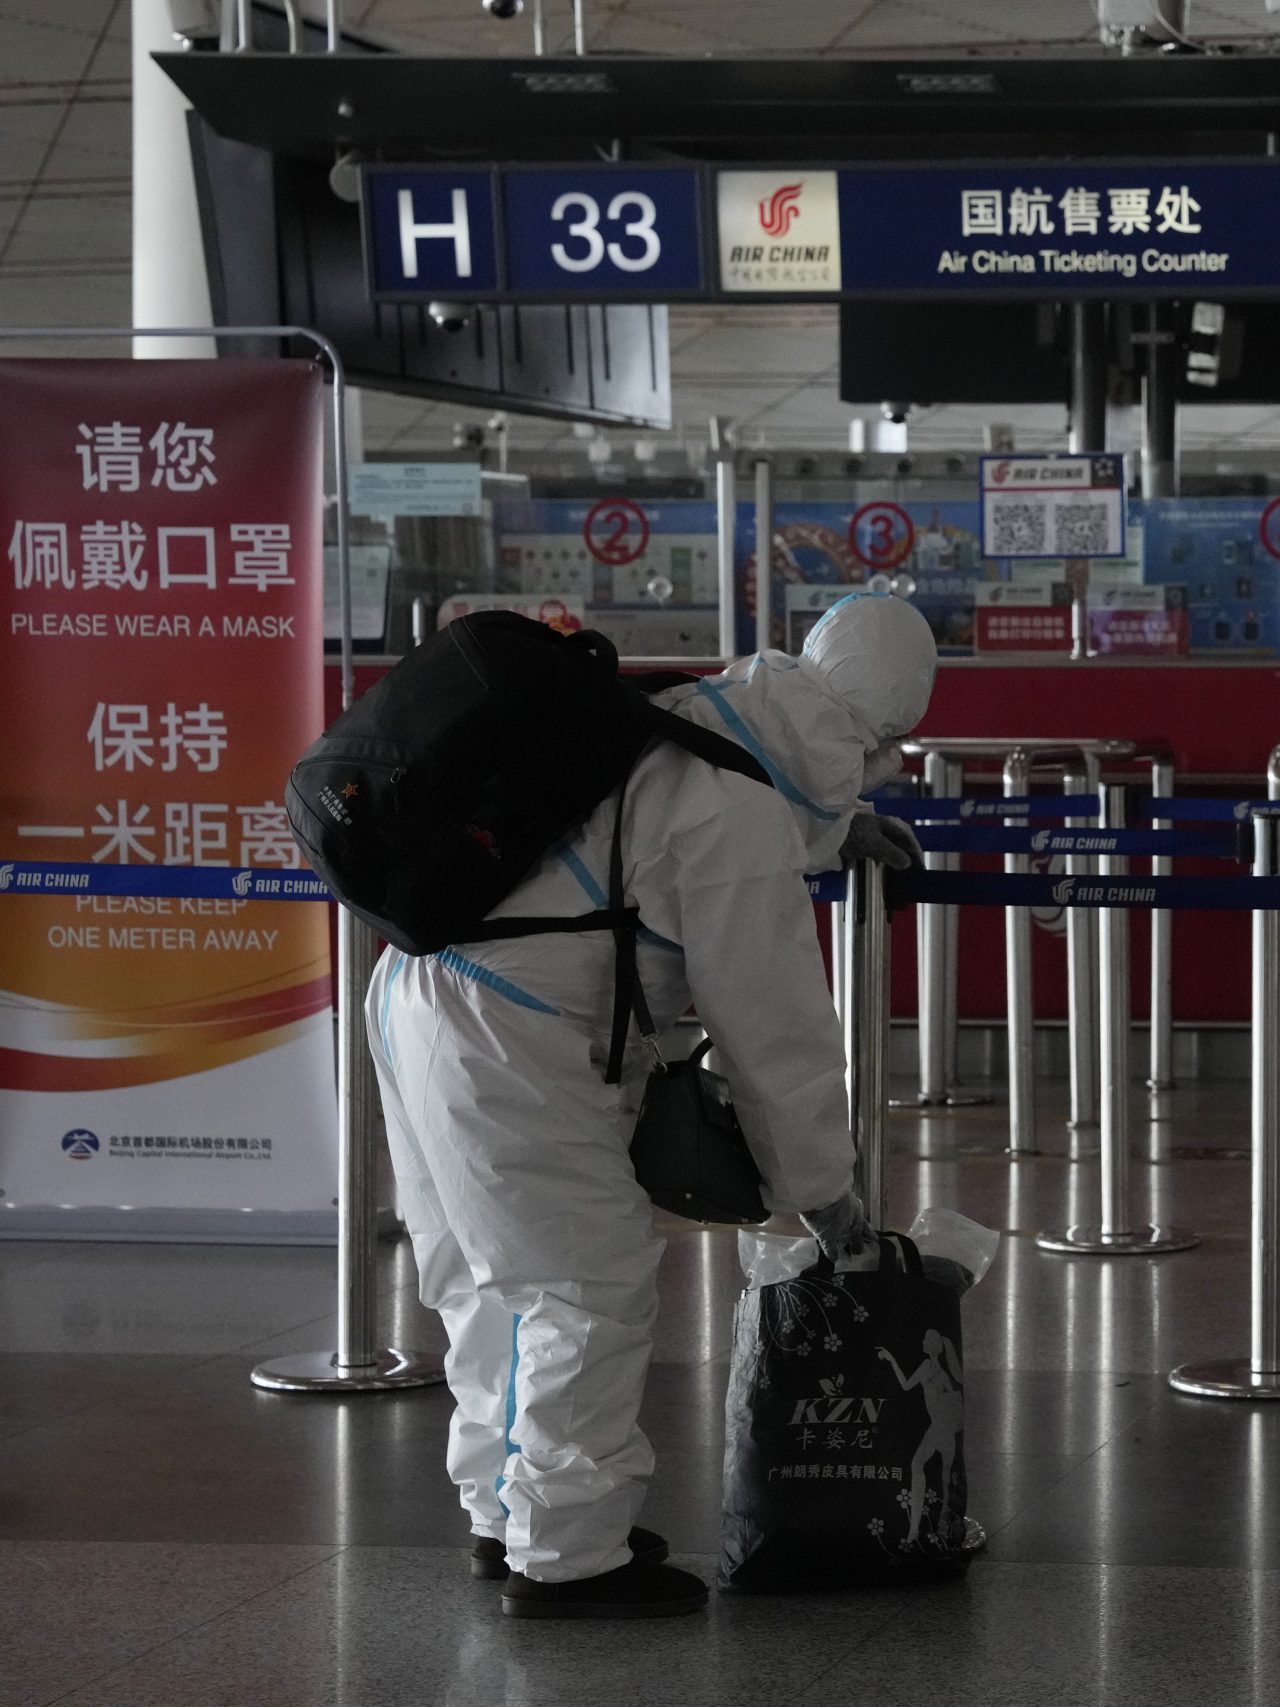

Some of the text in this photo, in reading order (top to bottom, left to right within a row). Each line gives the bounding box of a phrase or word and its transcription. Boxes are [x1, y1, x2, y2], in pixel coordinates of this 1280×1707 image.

[960, 186, 1202, 236] 国航售票处
[398, 189, 471, 278] H
[551, 191, 661, 273] 33
[730, 245, 829, 263] AIR CHINA
[937, 249, 1228, 277] Air China Ticketing Counter
[75, 421, 218, 493] 请您
[1013, 468, 1083, 480] AIR CHINA
[7, 519, 296, 591] 佩戴口罩
[11, 613, 296, 638] PLEASE WEAR A MASK
[87, 702, 228, 773] 保持
[17, 799, 300, 869] 一米距离
[1051, 837, 1117, 850] AIR CHINA
[17, 873, 90, 888] AIR CHINA
[255, 880, 329, 894] AIR CHINA
[76, 896, 247, 915] PLEASE KEEP
[1077, 888, 1156, 901] AIR CHINA
[48, 926, 279, 951] ONE METER AWAY
[788, 1397, 886, 1425] KZN
[796, 1427, 874, 1450] 卡姿尼
